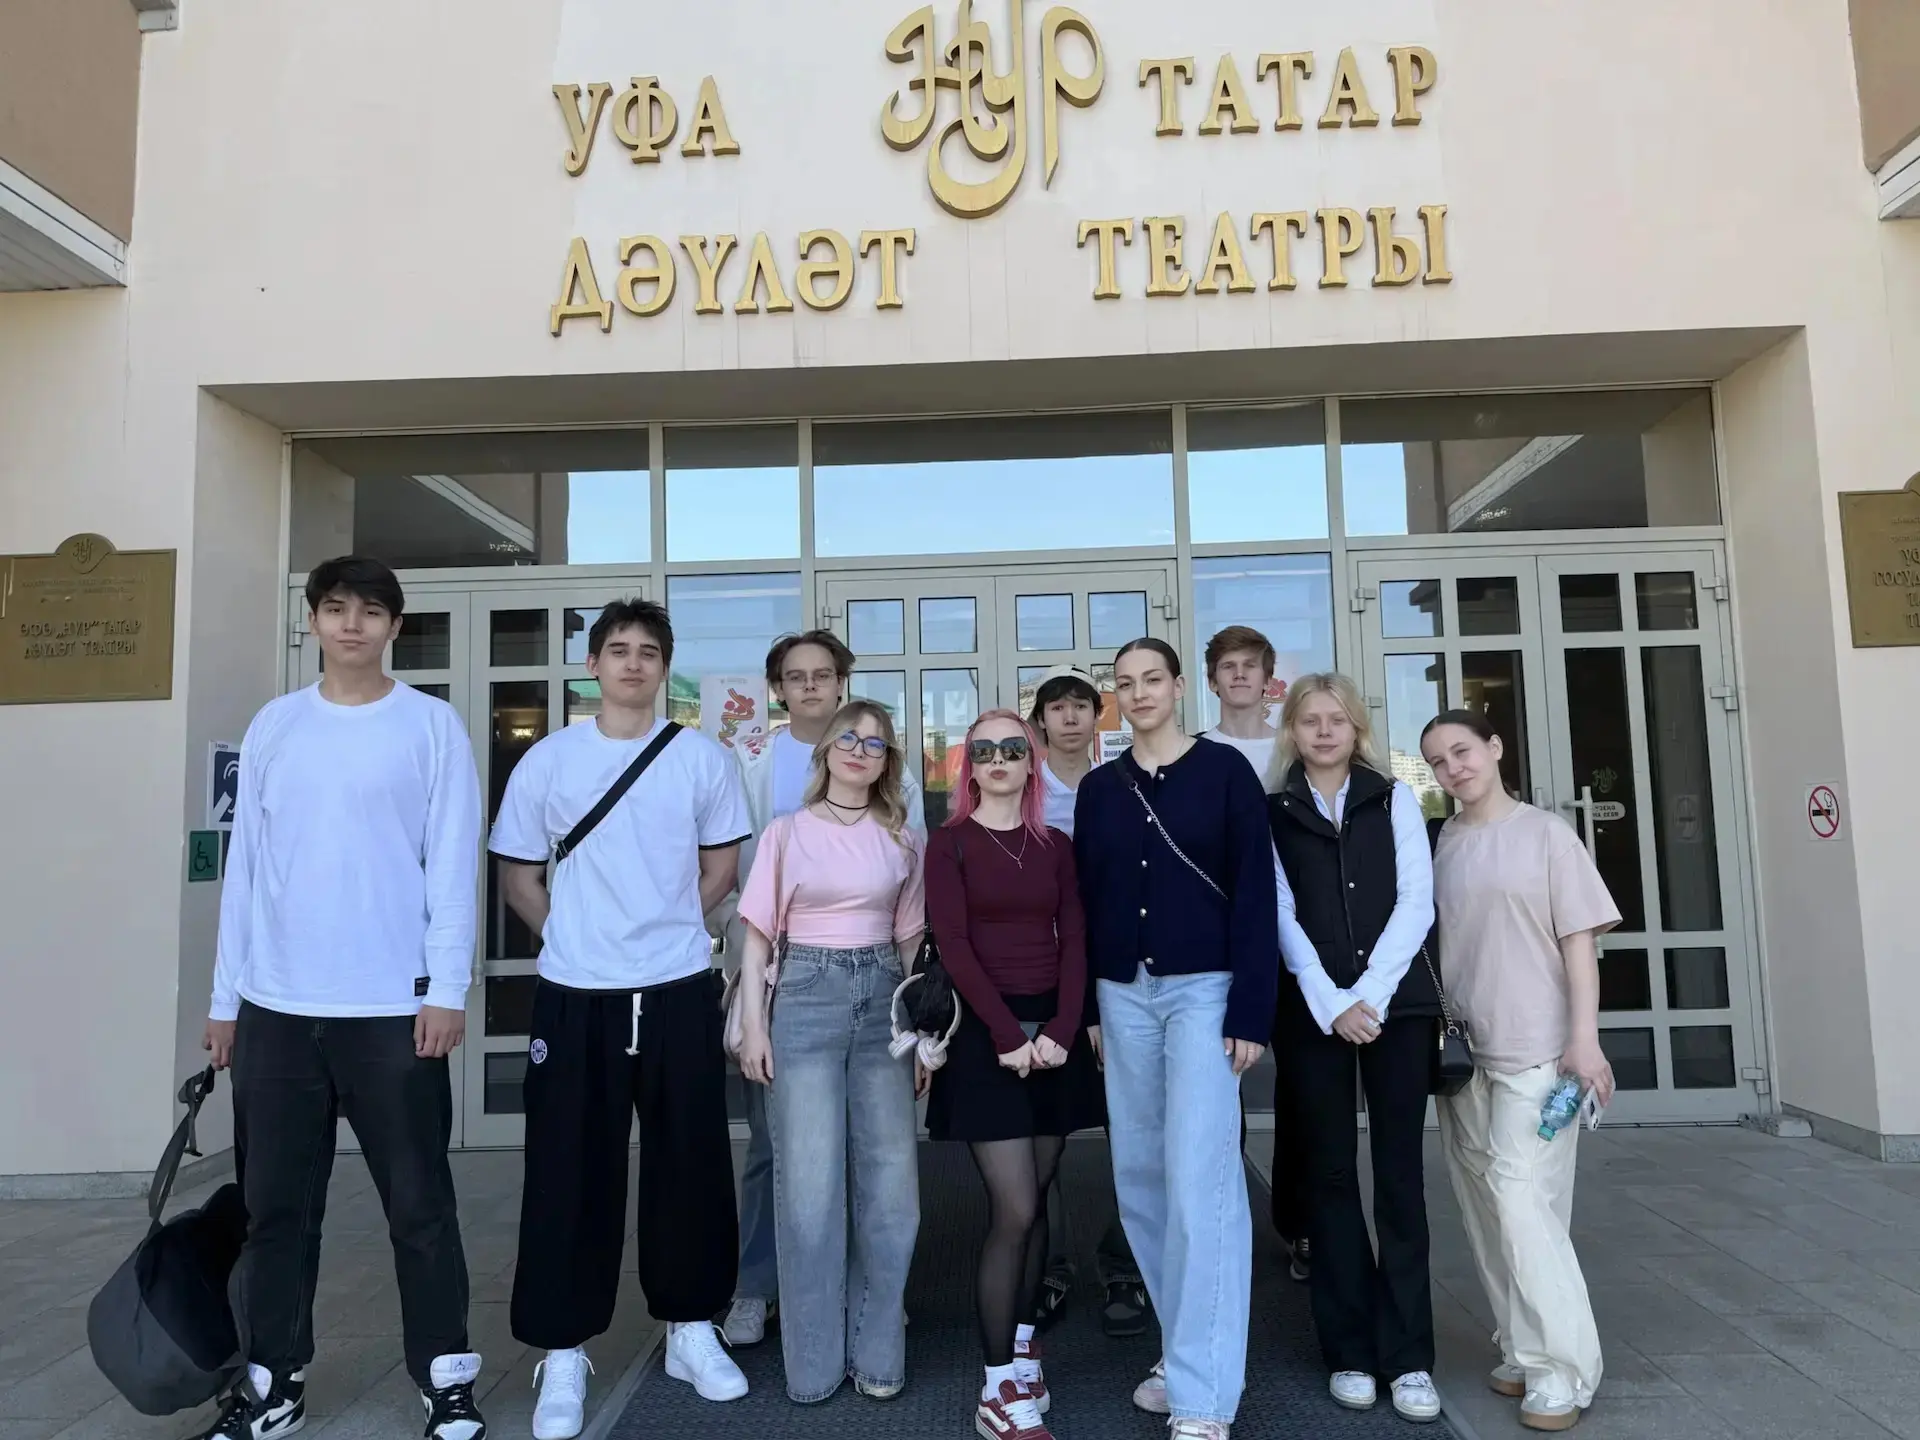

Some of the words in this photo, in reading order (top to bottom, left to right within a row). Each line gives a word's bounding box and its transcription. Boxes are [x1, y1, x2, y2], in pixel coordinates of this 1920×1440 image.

[552, 74, 740, 176] УФА
[1139, 45, 1438, 136] ТАТАР
[550, 227, 916, 336] ДӘҮЛӘТ
[1077, 205, 1454, 299] ТЕАТРЫ
[83, 639, 137, 656] ТЕАТРЫ
[102, 620, 142, 636] ТАТАР
